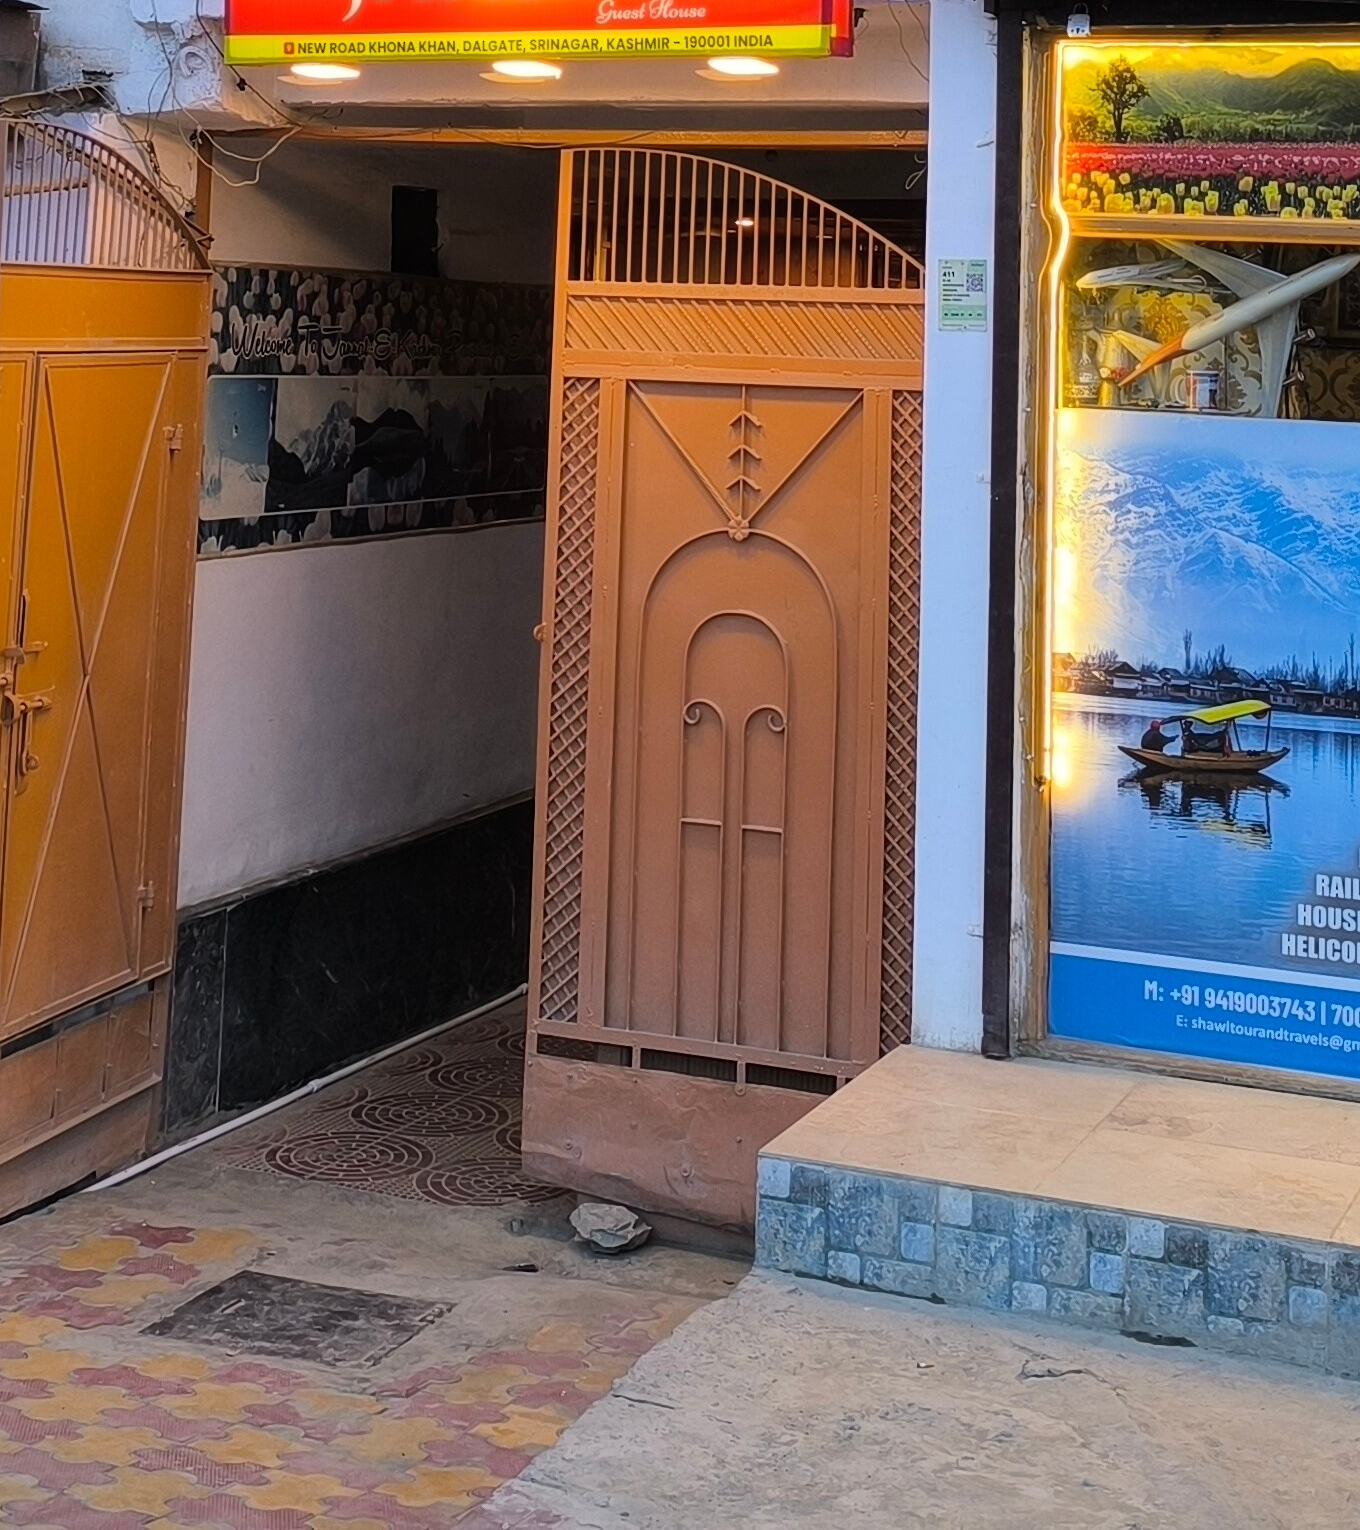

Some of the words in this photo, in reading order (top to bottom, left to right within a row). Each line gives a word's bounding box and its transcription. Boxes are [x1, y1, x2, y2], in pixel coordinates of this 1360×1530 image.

[596, 0, 645, 24] Guest
[649, 0, 706, 21] House
[298, 42, 325, 54] NEW
[330, 41, 366, 54] ROAD
[369, 41, 416, 53] KHONA
[419, 40, 460, 54] KHAN,
[464, 40, 526, 54] DALGATE,
[530, 38, 602, 53] SRINAGAR,
[606, 37, 670, 51] KASHMIR
[684, 37, 731, 49] 190001
[734, 36, 773, 48] INDIA
[231, 322, 293, 359] Welcome
[297, 322, 319, 356] To
[1144, 980, 1163, 1001] M:
[1170, 985, 1199, 1006] +91
[1205, 988, 1315, 1022] 9419003743
[1176, 1015, 1188, 1027] E:
